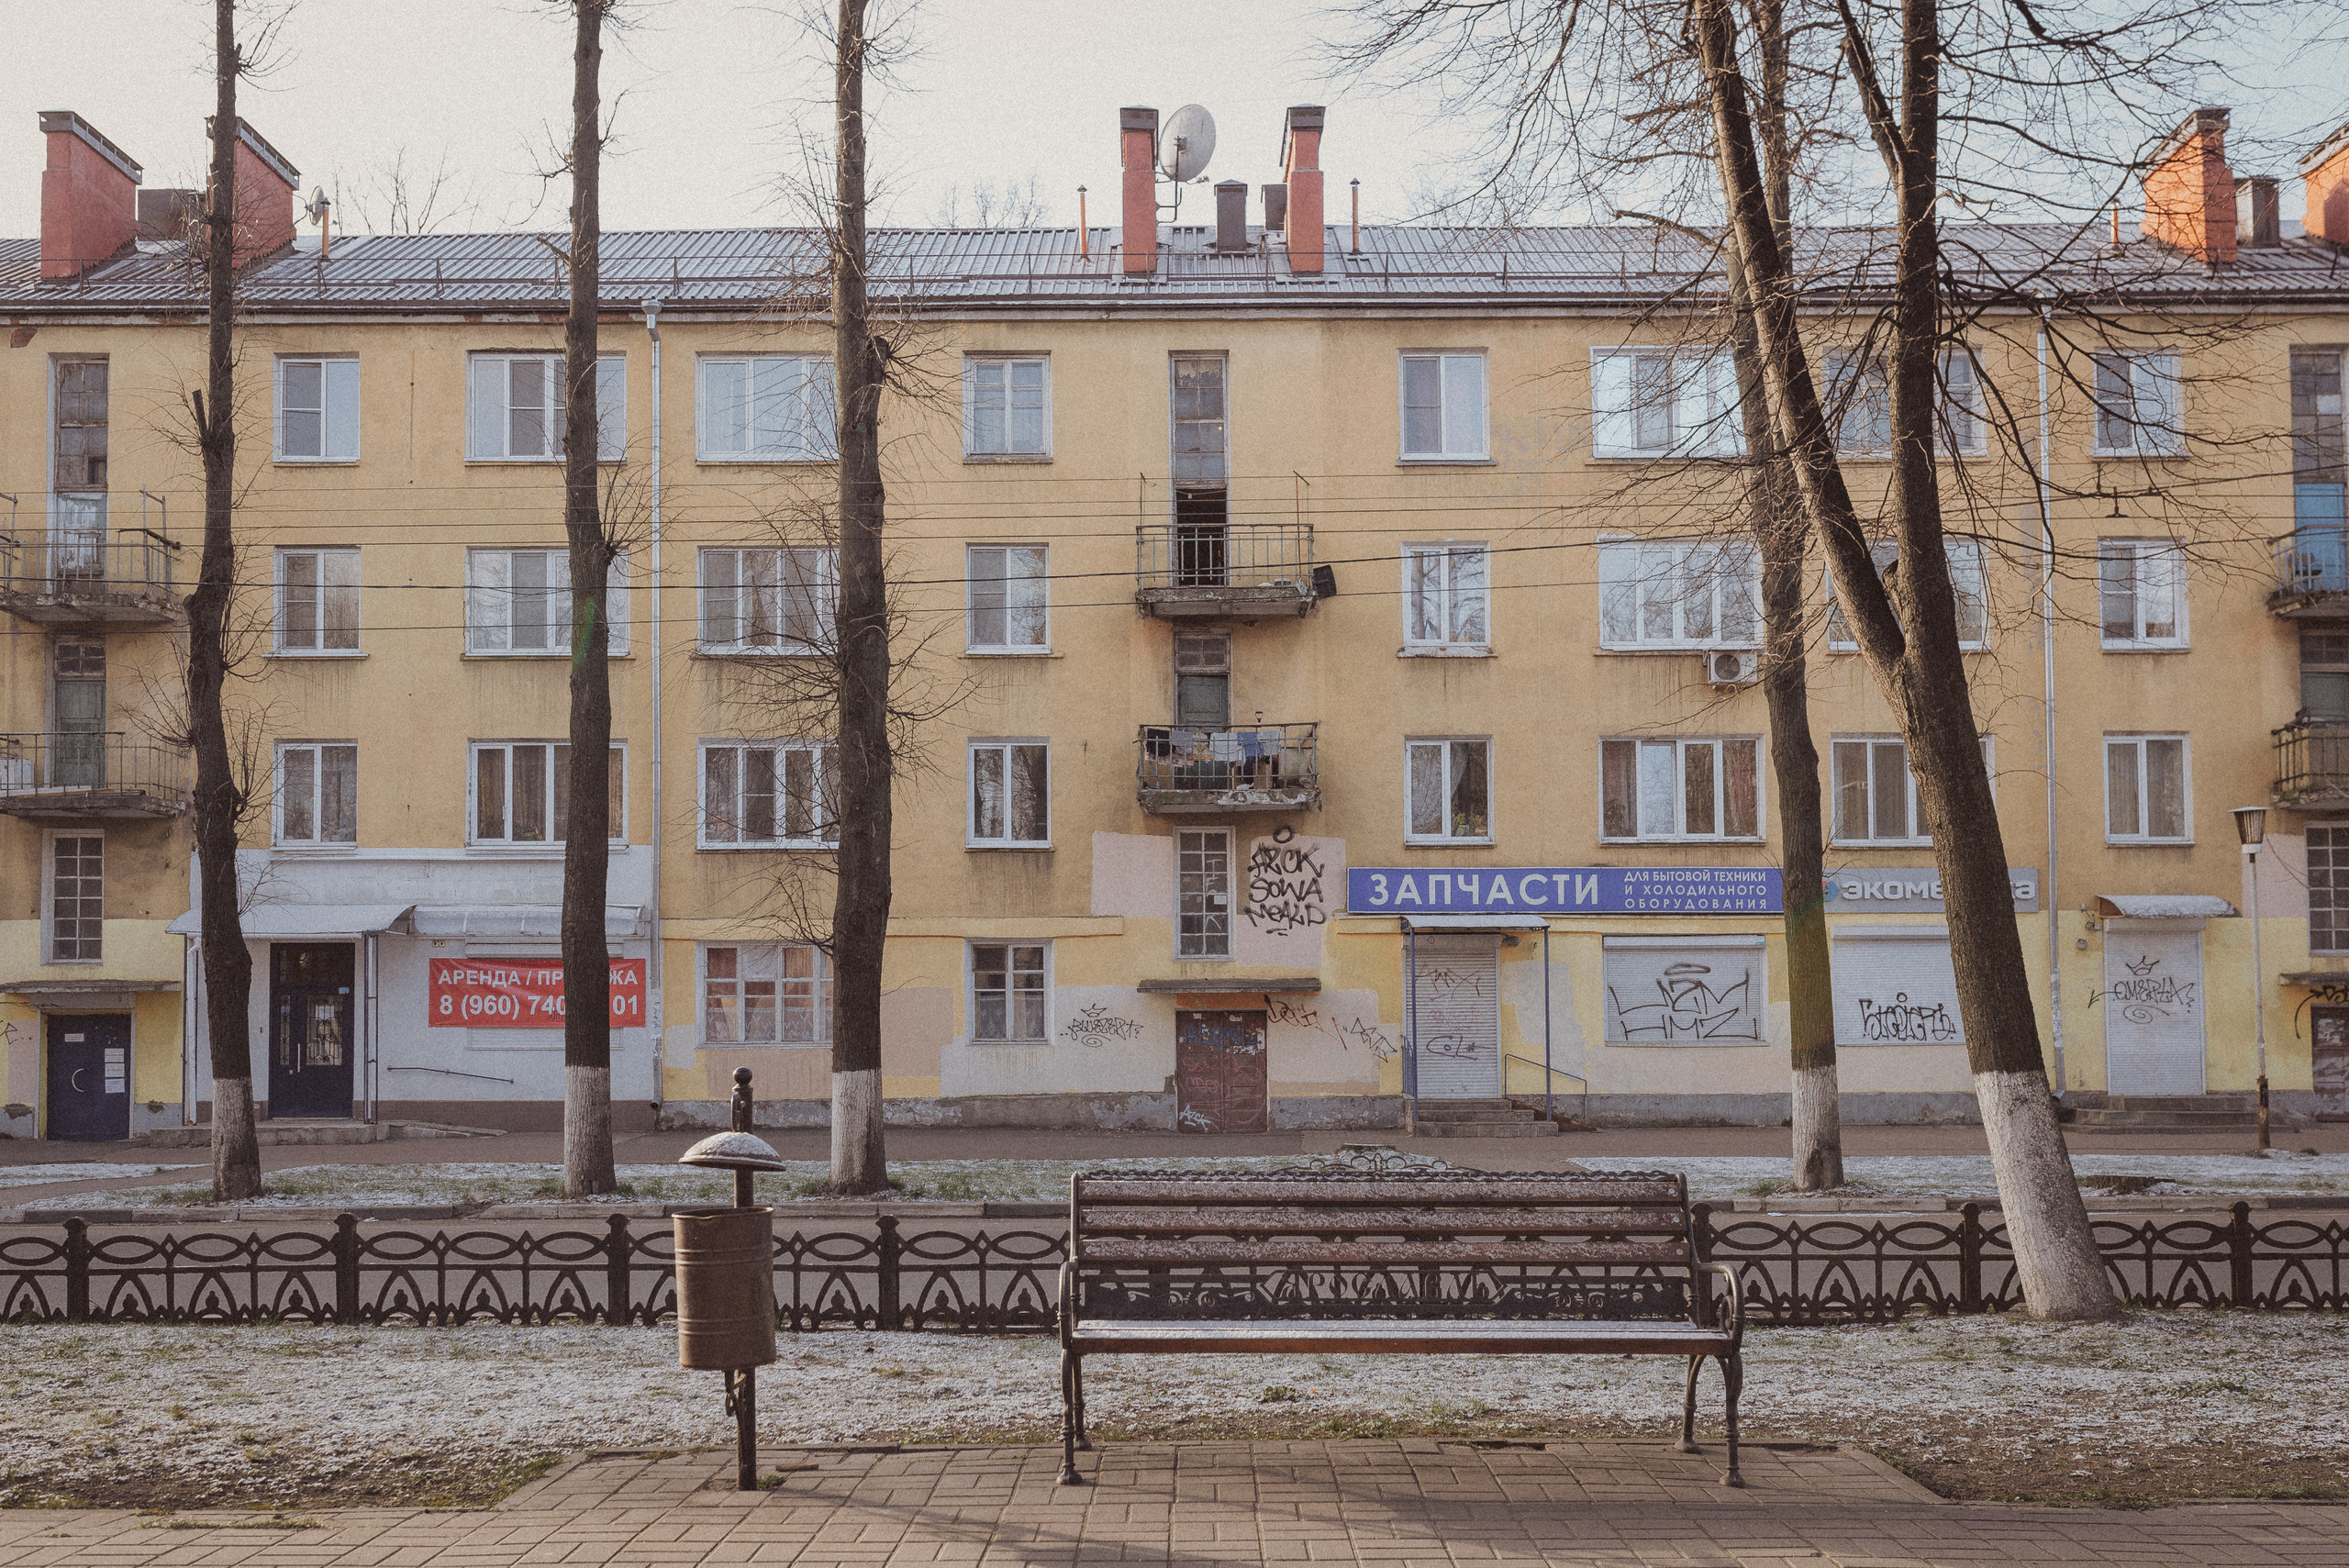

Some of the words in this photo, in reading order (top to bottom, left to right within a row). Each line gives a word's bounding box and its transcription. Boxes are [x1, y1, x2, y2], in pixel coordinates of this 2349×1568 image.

[1624, 872, 1649, 883] ДЛЯ
[1653, 869, 1710, 882] БЫТОВОЙ
[1714, 871, 1766, 883] ТЕХНИКИ
[1368, 873, 1598, 906] ЗАПЧАСТИ
[1624, 884, 1633, 895] И
[1642, 884, 1766, 896] ХОЛОДИЛЬНОГО
[1624, 898, 1767, 910] ОБОРУДОВАНИЯ
[438, 969, 521, 988] АРЕНДА
[526, 970, 532, 985] /
[538, 970, 639, 985] ПРЖА
[440, 995, 453, 1015] 8
[461, 995, 520, 1020] (960)
